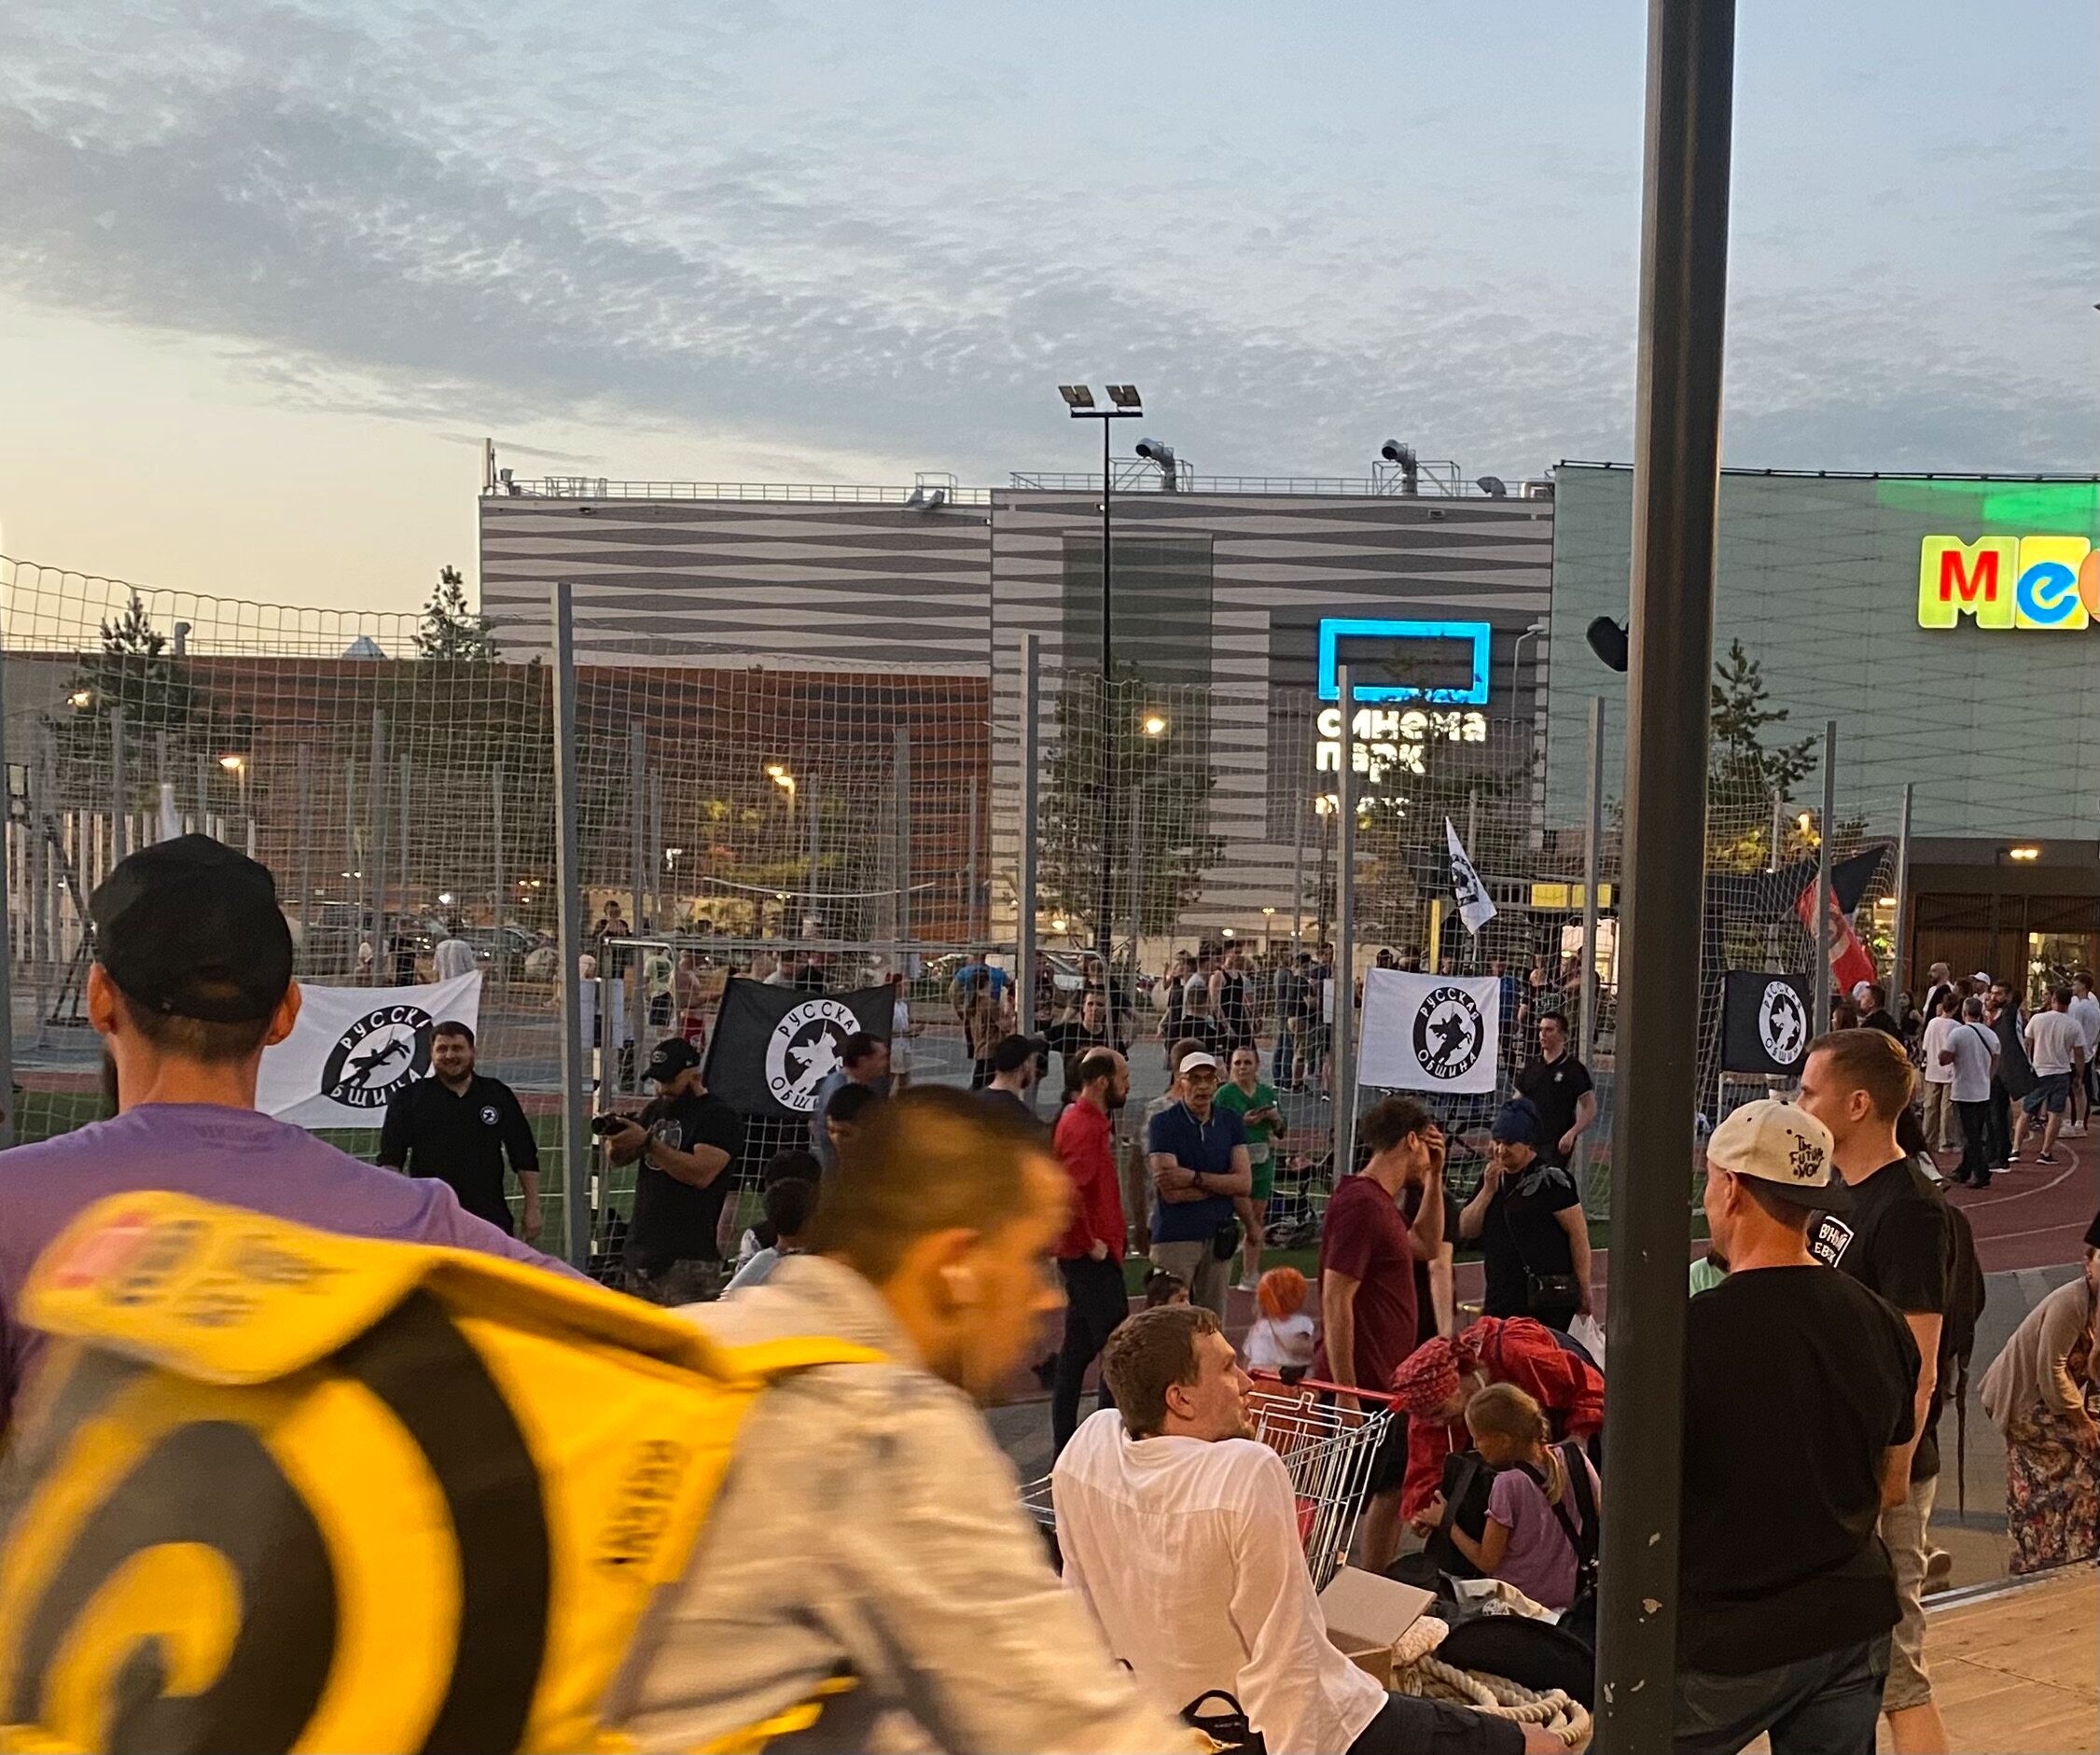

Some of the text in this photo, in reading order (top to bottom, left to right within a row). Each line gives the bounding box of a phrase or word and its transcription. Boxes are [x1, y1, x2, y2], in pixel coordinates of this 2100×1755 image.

[1937, 549, 2082, 625] Ме
[1317, 708, 1486, 742] синема
[1316, 741, 1425, 783] парк
[778, 1002, 855, 1038] РУССКА
[1419, 988, 1480, 1020] РУССКАЯ
[771, 1077, 818, 1108] ОБЩ
